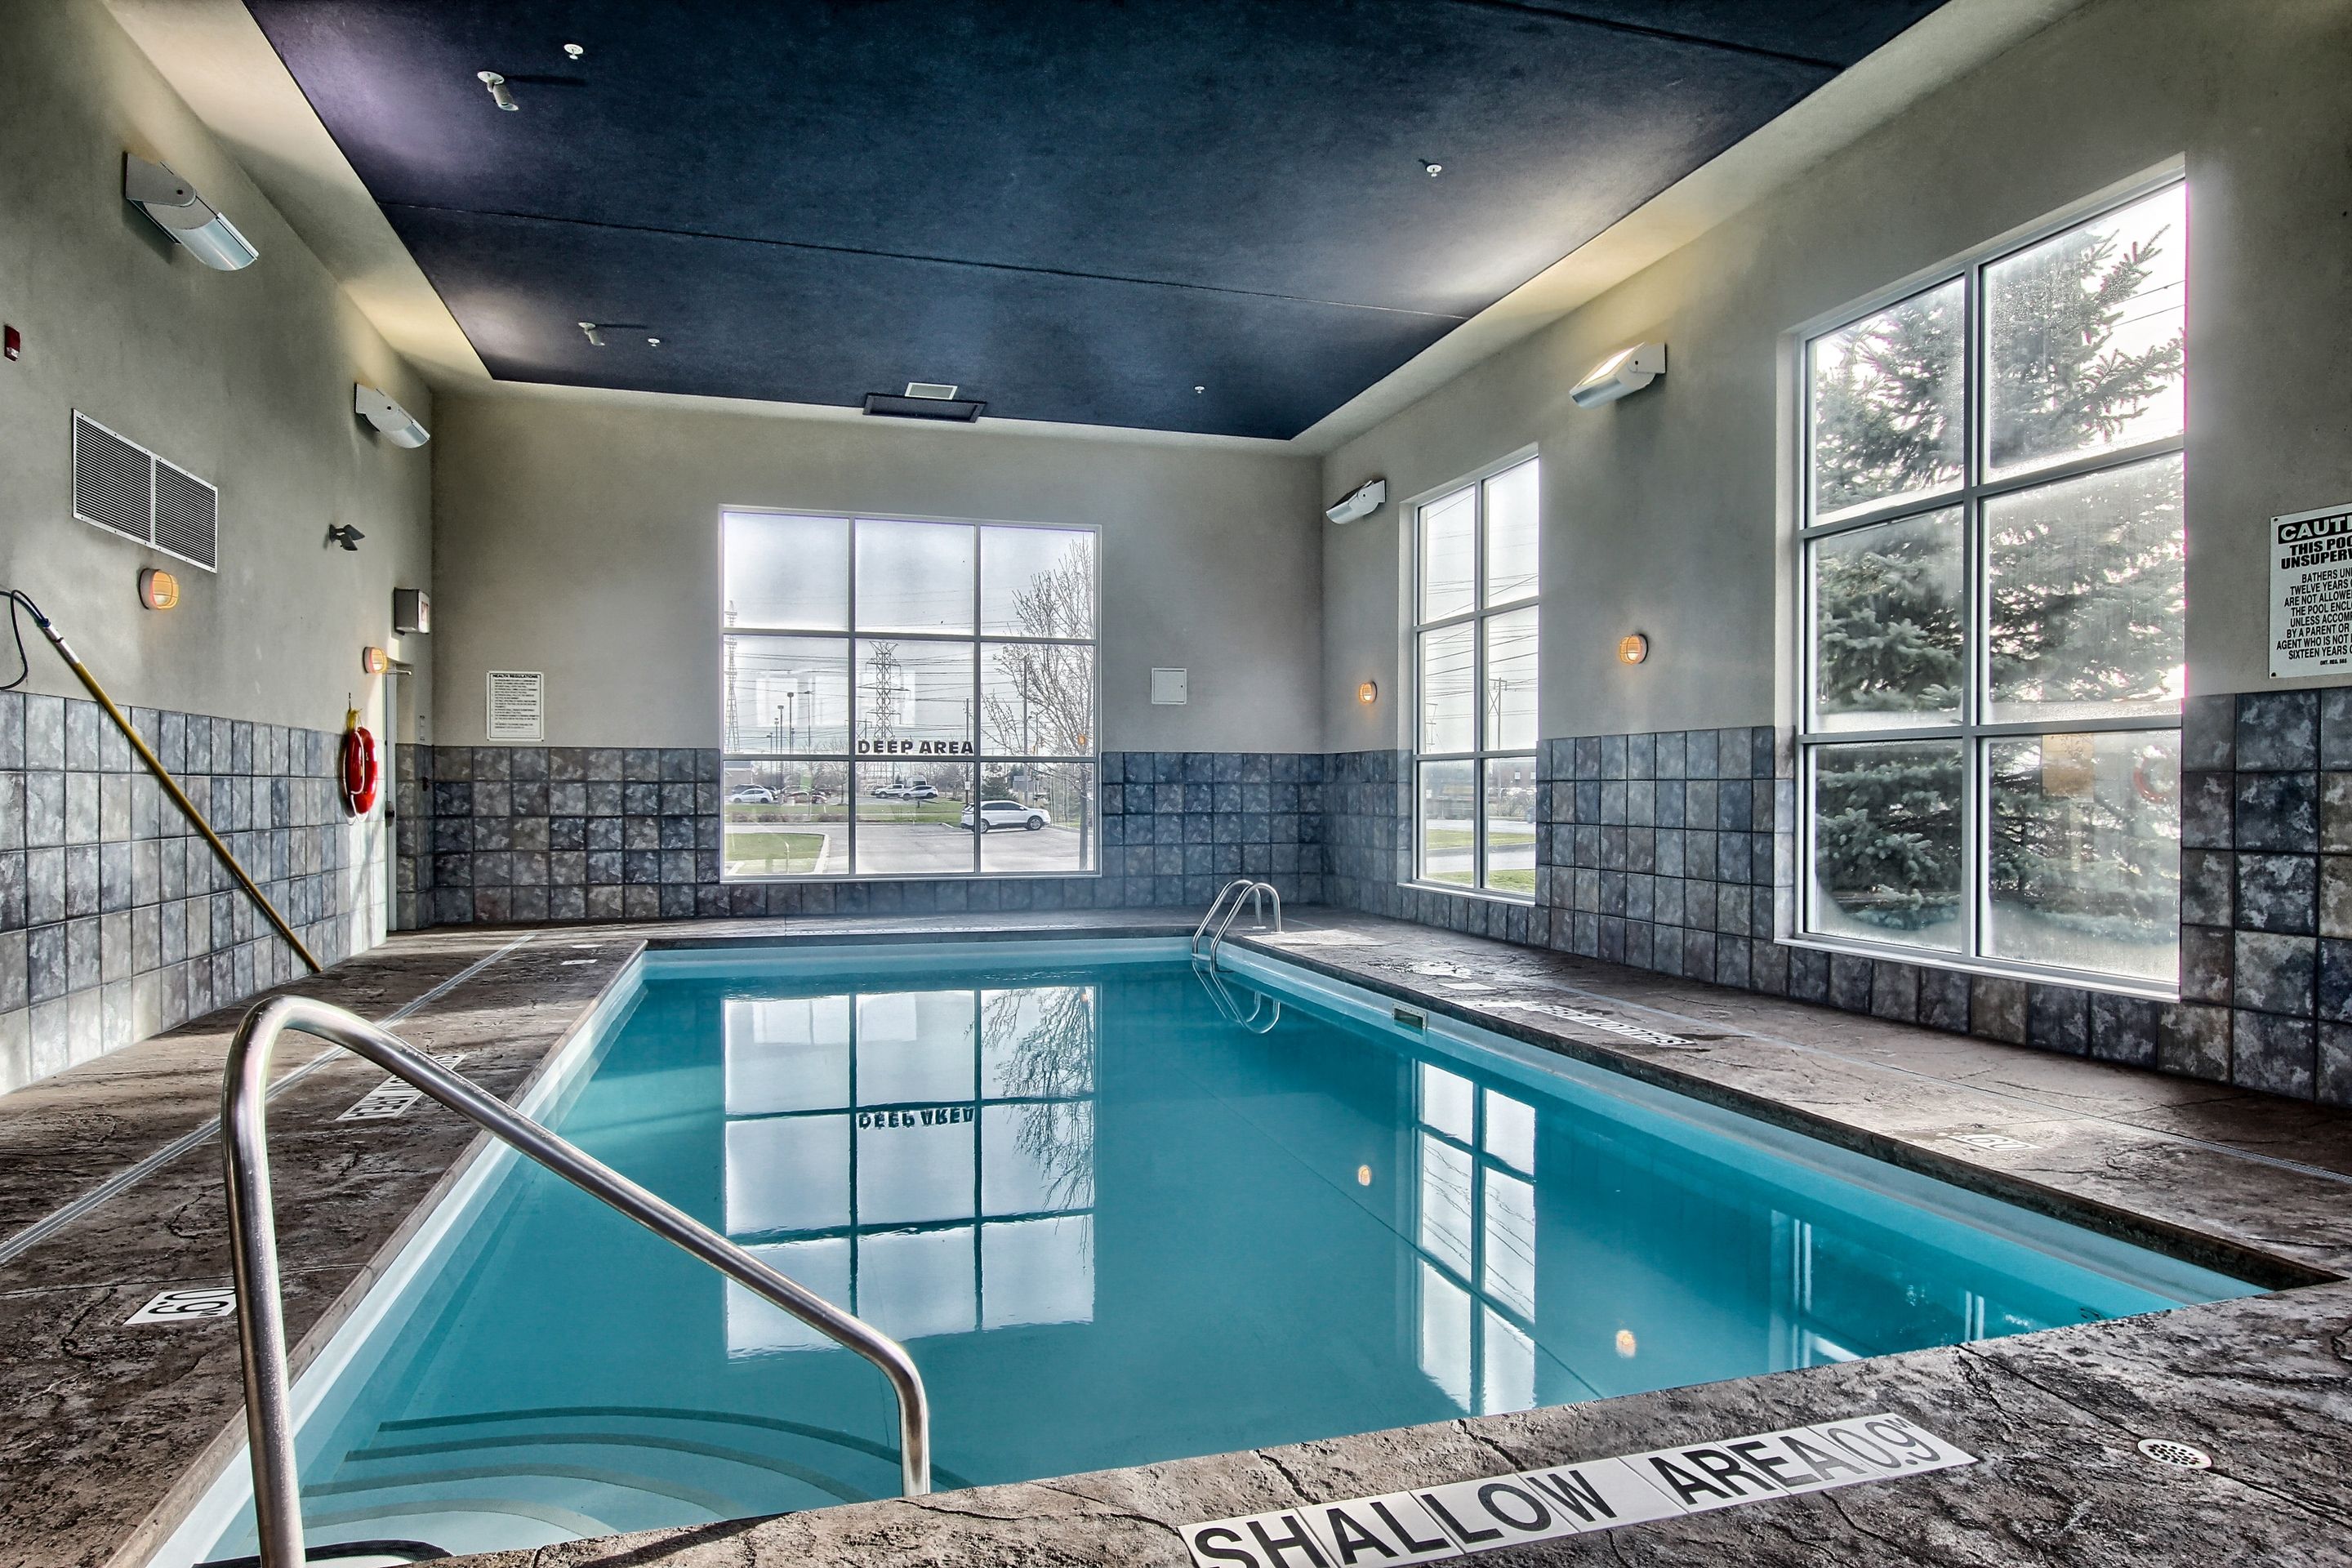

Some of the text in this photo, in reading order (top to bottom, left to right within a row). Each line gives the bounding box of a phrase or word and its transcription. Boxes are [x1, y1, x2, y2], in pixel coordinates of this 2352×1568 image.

[2289, 541, 2323, 556] THIS
[2302, 568, 2352, 583] BATHERS UN
[2290, 582, 2320, 595] TWELVE
[2323, 579, 2349, 591] YEARS
[2284, 590, 2352, 607] ARE NOT ALLOWE
[2291, 600, 2352, 617] THE POOL ENCL
[2290, 615, 2320, 627] UNLESS
[2287, 623, 2350, 639] BY A PARENT OR
[2277, 639, 2302, 650] AGENT
[2304, 637, 2322, 648] WHO
[2323, 635, 2331, 645] IS
[2332, 634, 2349, 644] NOT
[2288, 648, 2319, 660] SIXTEEN
[2322, 645, 2348, 657] YEARS
[858, 740, 973, 754] DEEP AREA
[1194, 1470, 1618, 1568] SHALLOW
[1648, 1436, 1868, 1505] AREA
